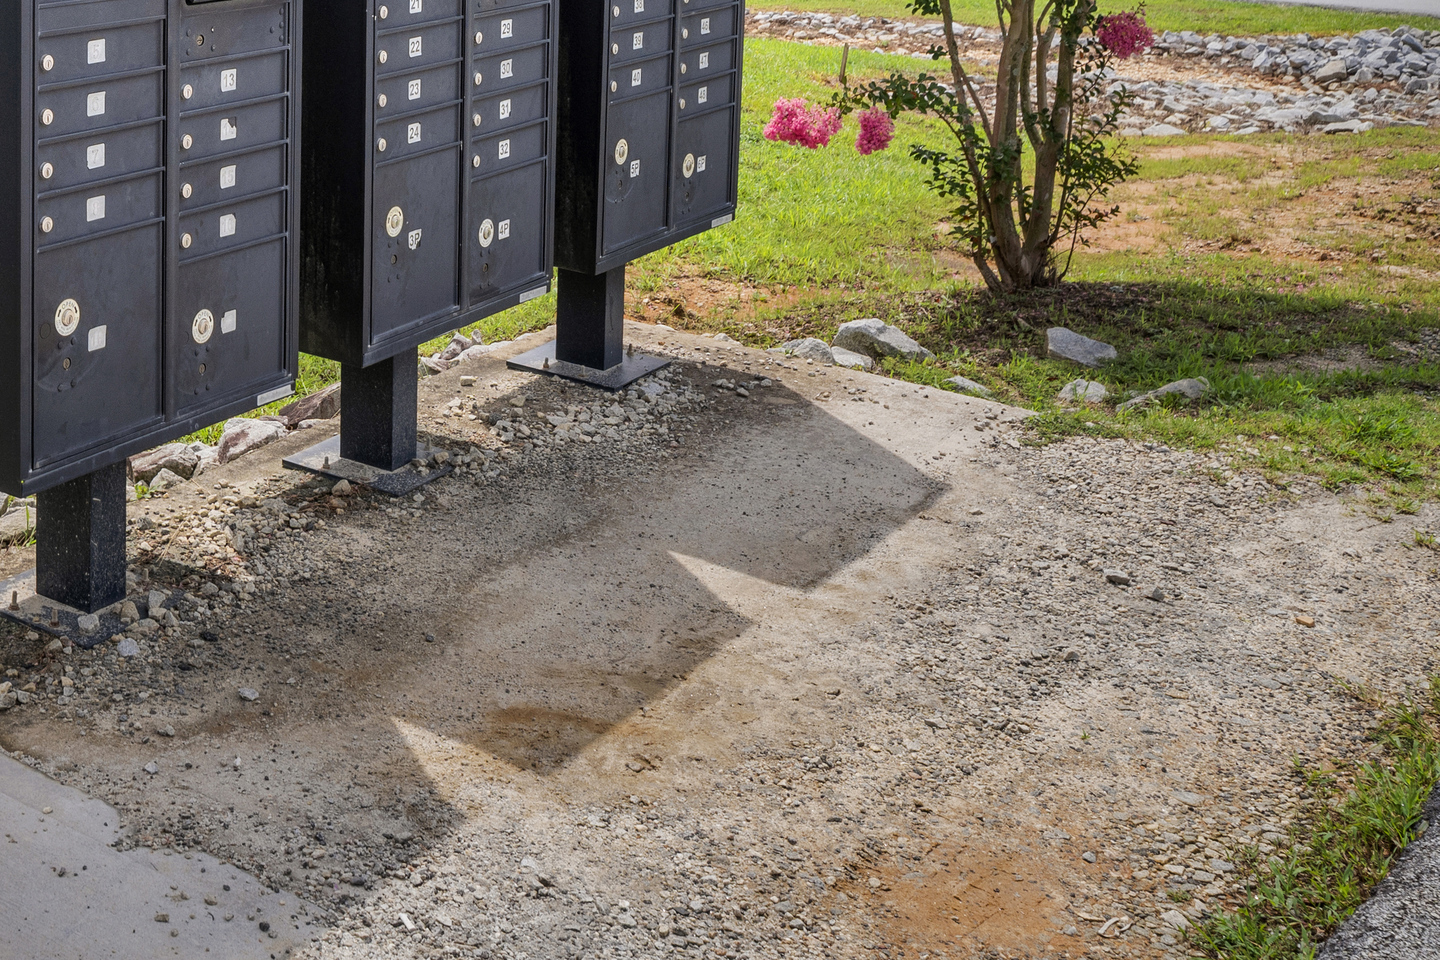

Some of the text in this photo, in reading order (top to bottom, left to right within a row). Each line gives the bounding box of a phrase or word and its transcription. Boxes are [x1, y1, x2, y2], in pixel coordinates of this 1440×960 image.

[502, 22, 511, 35] 29
[410, 40, 420, 54] 22
[634, 35, 642, 46] 39
[92, 44, 100, 60] 5
[501, 62, 511, 74] 30
[222, 72, 236, 88] 13
[632, 70, 640, 84] 40
[409, 82, 420, 96] 23
[92, 96, 100, 112] 6
[500, 102, 510, 116] 31
[408, 126, 420, 140] 24
[91, 148, 100, 164] 7
[499, 142, 509, 156] 32
[499, 222, 509, 236] 4P
[409, 232, 420, 247] 3P
[61, 300, 76, 310] OPEN
